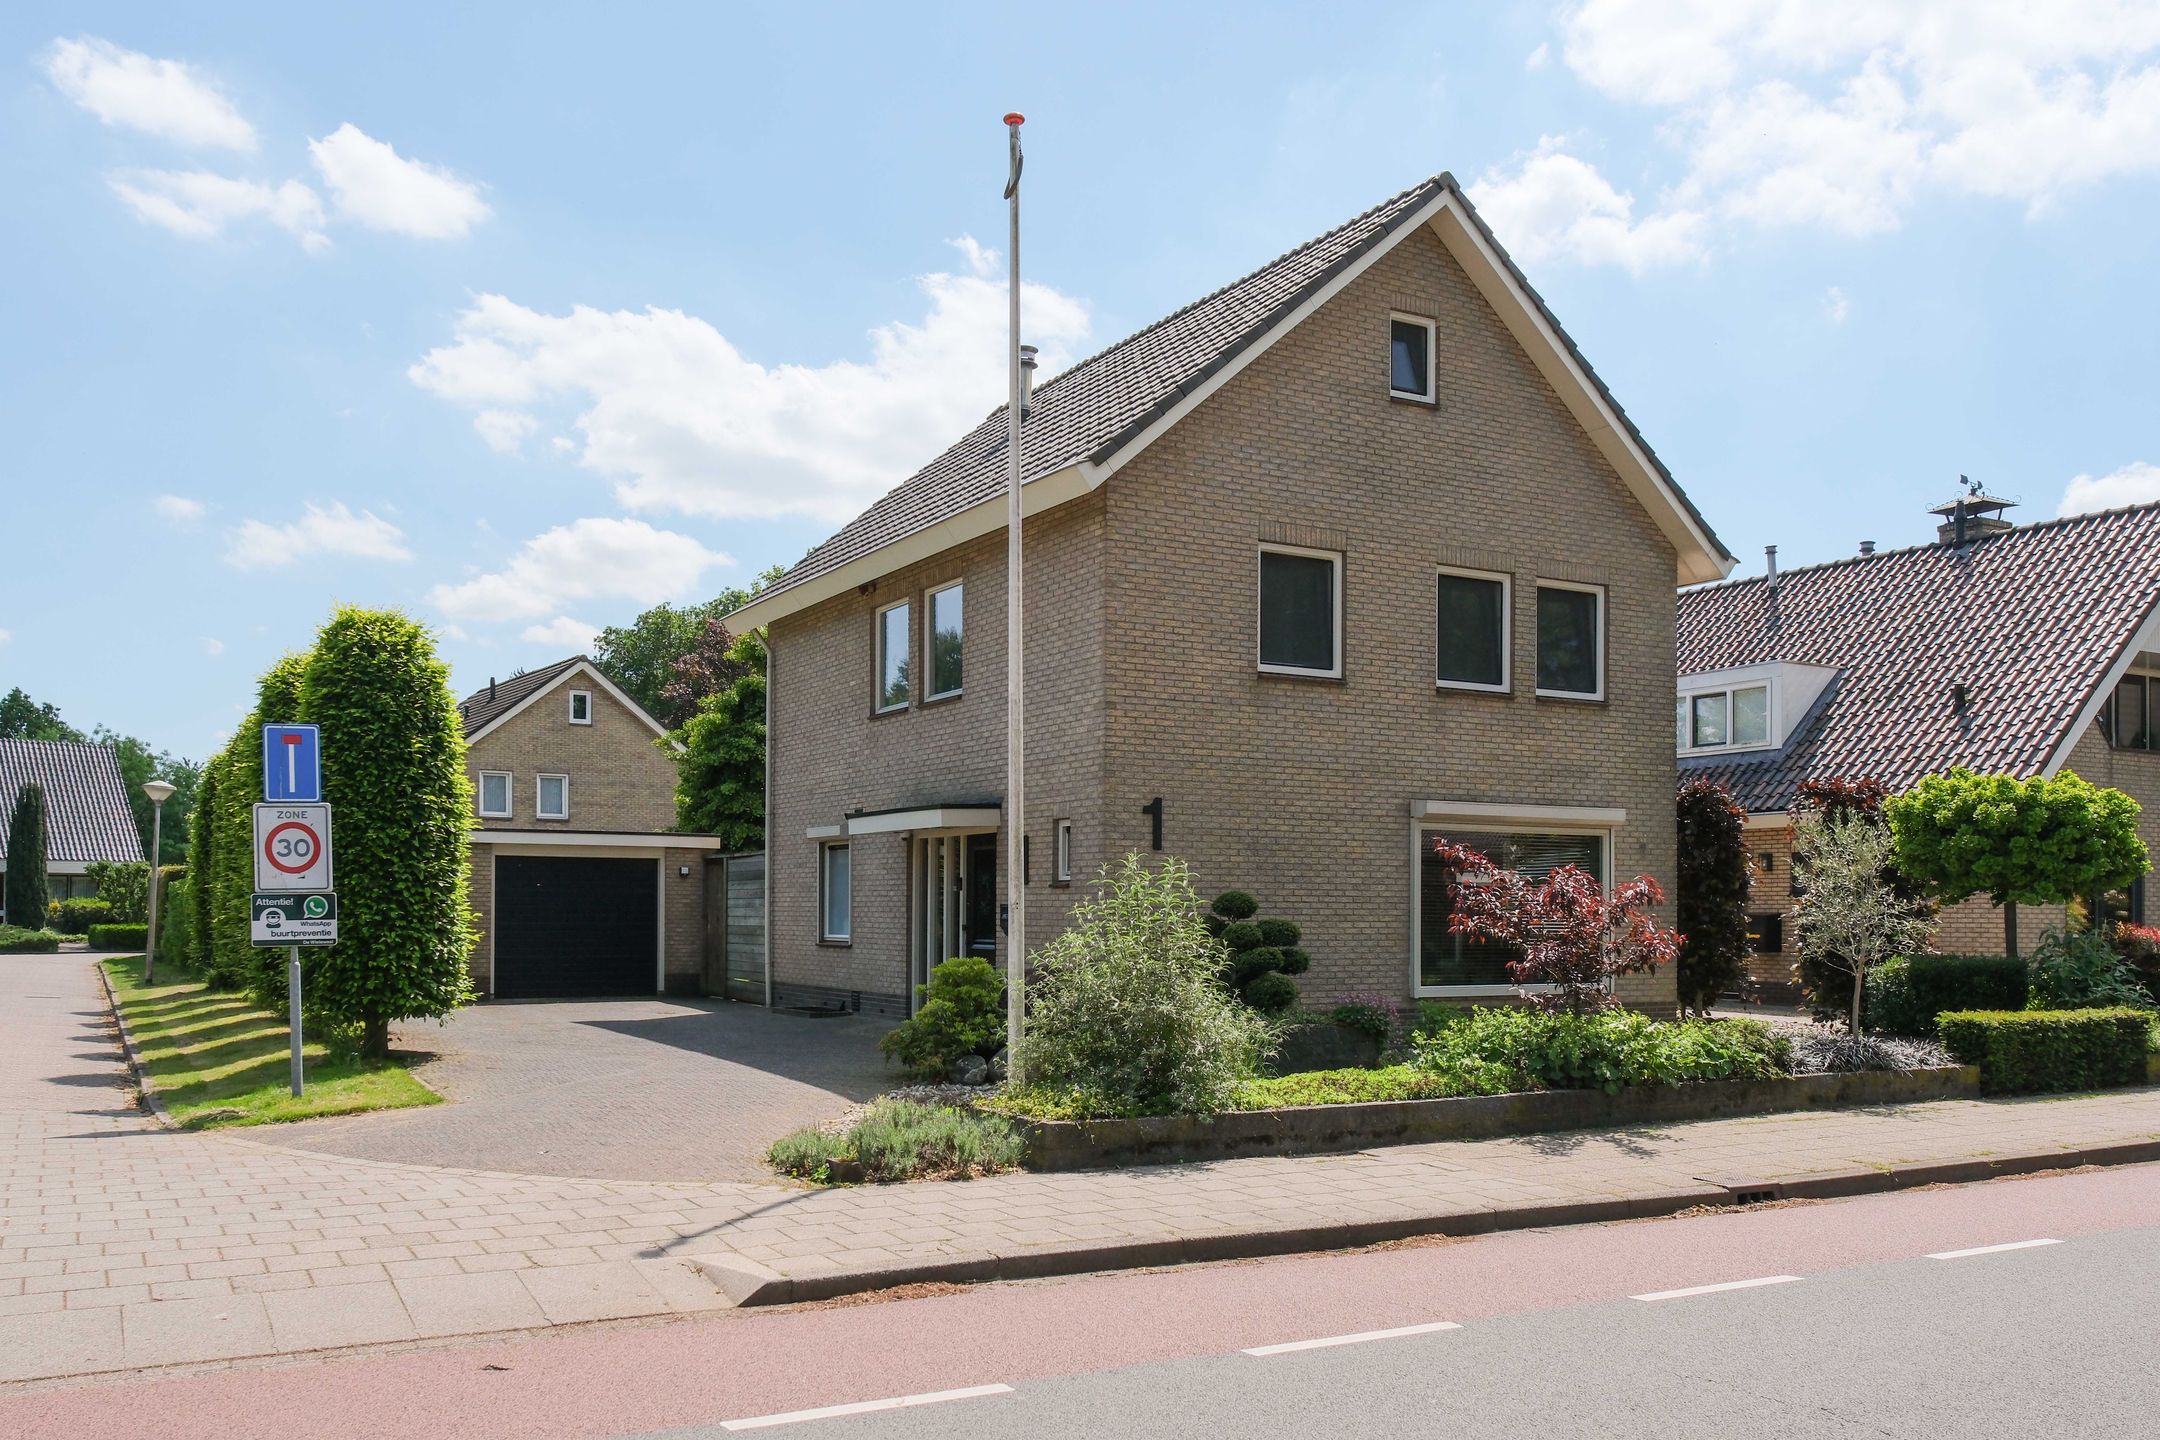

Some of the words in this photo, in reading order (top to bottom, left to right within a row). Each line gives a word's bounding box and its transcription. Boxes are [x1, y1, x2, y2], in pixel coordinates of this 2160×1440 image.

[277, 811, 308, 819] ZONE
[1143, 797, 1162, 850] 1
[277, 839, 310, 857] 30
[255, 898, 294, 906] Attentie!
[270, 930, 332, 938] buurtpreventie
